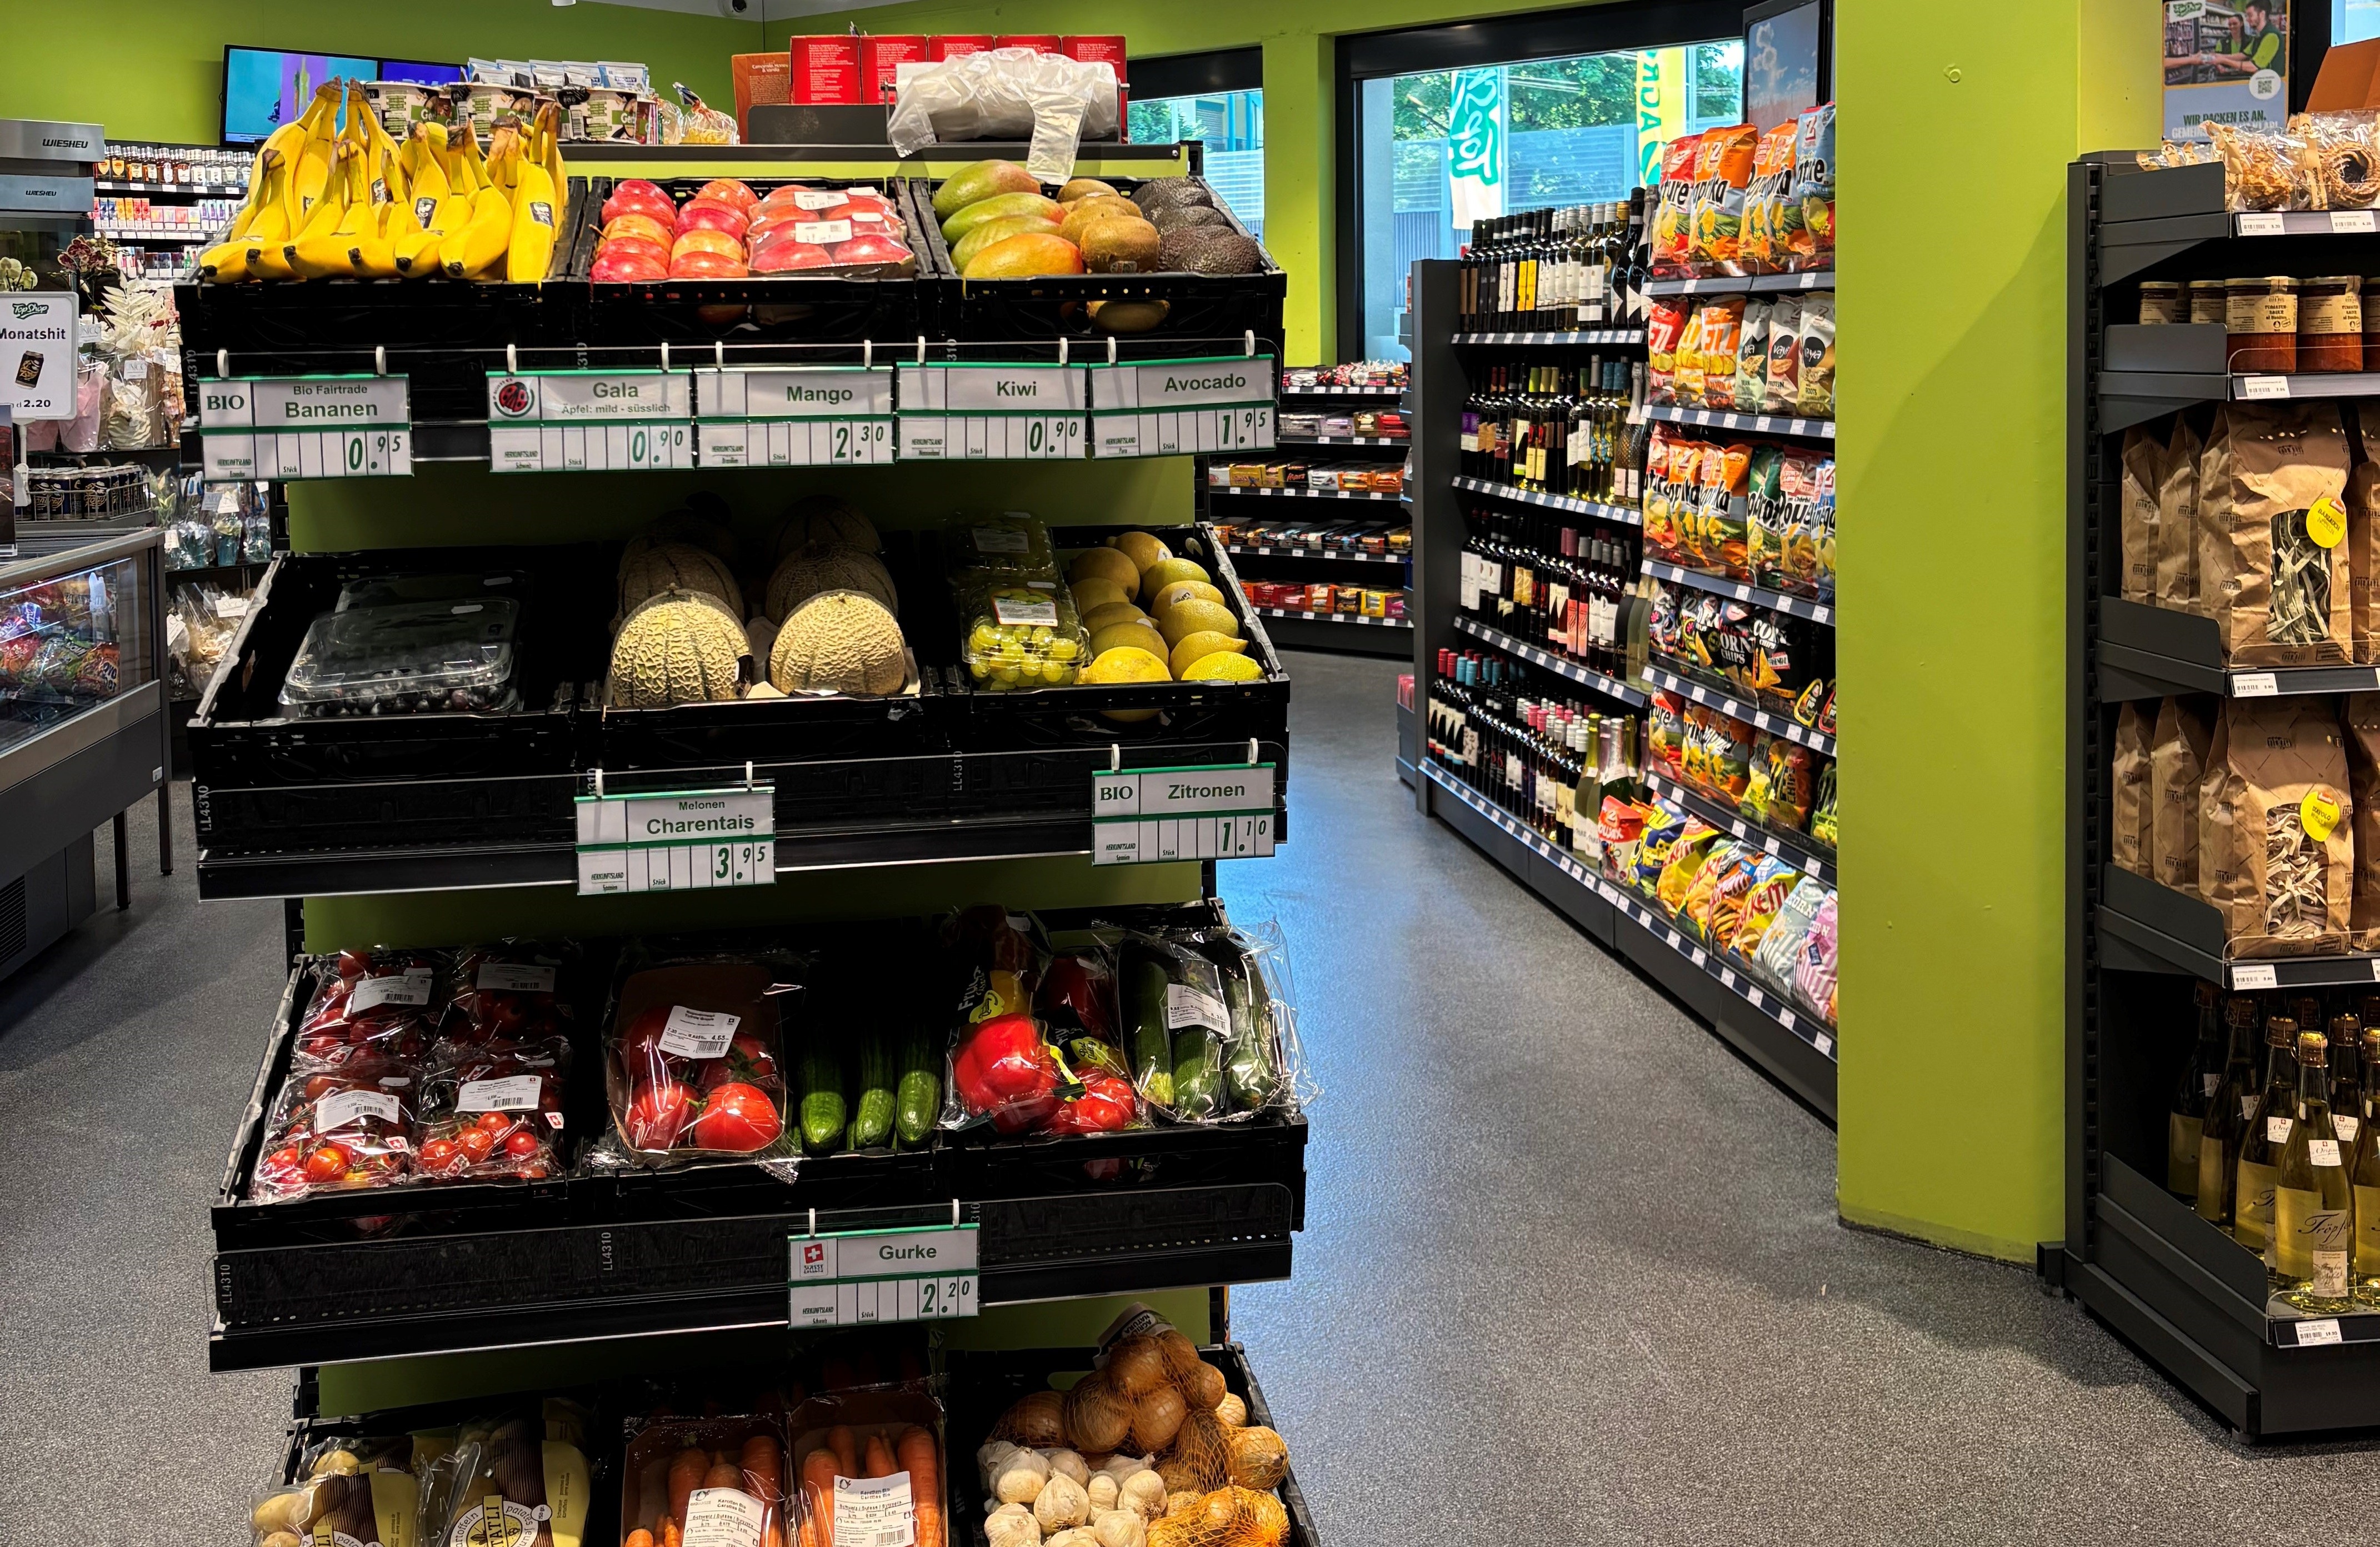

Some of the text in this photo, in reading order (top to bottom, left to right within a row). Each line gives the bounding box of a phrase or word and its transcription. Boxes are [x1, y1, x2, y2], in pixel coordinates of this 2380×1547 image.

[2183, 114, 2201, 126] WIR
[2239, 111, 2249, 122] ES
[43, 139, 88, 148] WIESHEU
[293, 385, 368, 395] Bio Fairtrade
[593, 382, 639, 398] Gala
[997, 381, 1037, 396] Kiwi
[1164, 373, 1246, 392] Avocado
[207, 395, 244, 410] BIO
[787, 386, 853, 405] Mango
[286, 401, 378, 418] Bananen
[562, 404, 592, 415] Äpfel:
[596, 405, 618, 413] mild
[628, 403, 671, 412] süsslich
[1029, 421, 1077, 453] 0.90
[1223, 412, 1266, 445] 1.95
[633, 431, 683, 463] 0.90
[835, 426, 883, 458] 2.30
[349, 436, 401, 470] 0.95
[1100, 786, 1133, 801] BIO
[1168, 784, 1245, 799] Zitronen
[679, 801, 725, 811] Melonen
[647, 815, 754, 834] Charentais
[1223, 820, 1266, 851] 1.10
[716, 846, 766, 880] 3.95
[602, 1231, 612, 1271] LL4310
[879, 1245, 937, 1260] Gurke
[221, 1264, 231, 1304] LL4310
[921, 1280, 969, 1314] 2.20
[456, 1512, 479, 1547] artoffeln
[485, 1506, 503, 1547] TATLI
